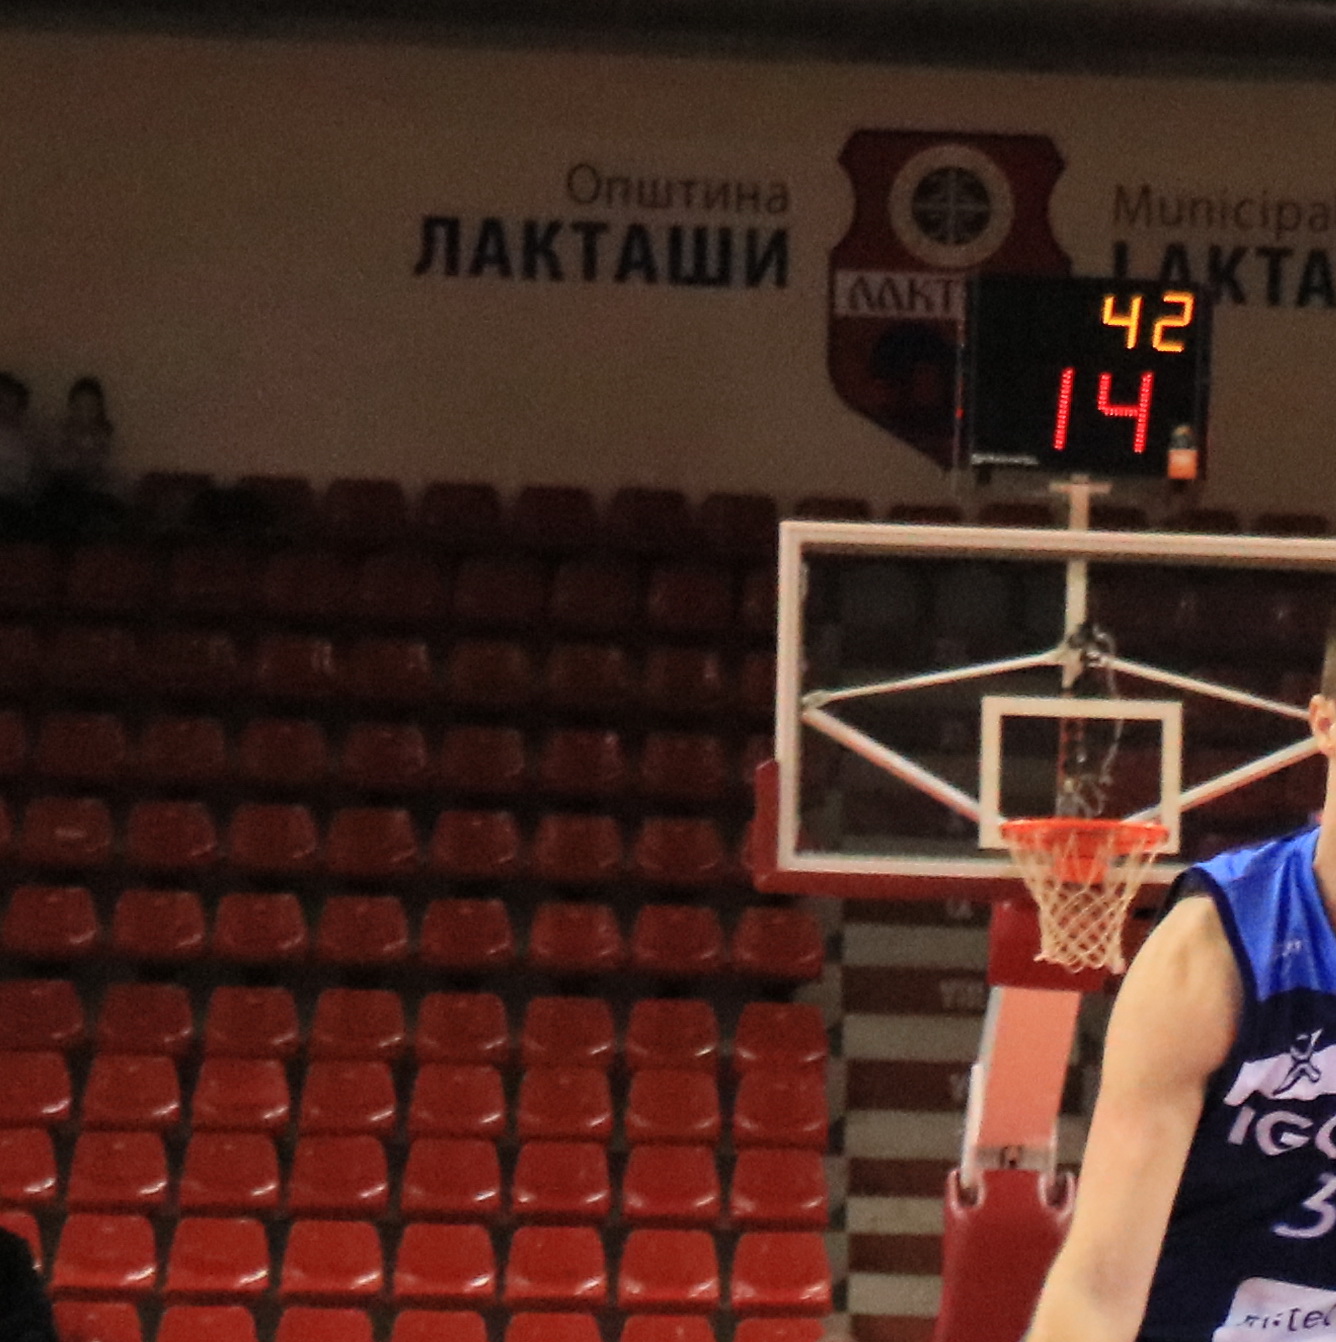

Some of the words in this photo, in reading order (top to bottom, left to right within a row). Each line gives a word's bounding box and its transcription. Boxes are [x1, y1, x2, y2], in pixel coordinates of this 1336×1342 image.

[566, 163, 792, 215] Општина
[413, 216, 790, 290] ЛАКТАШИ
[1101, 290, 1195, 353] 42
[1052, 366, 1156, 454] 14
